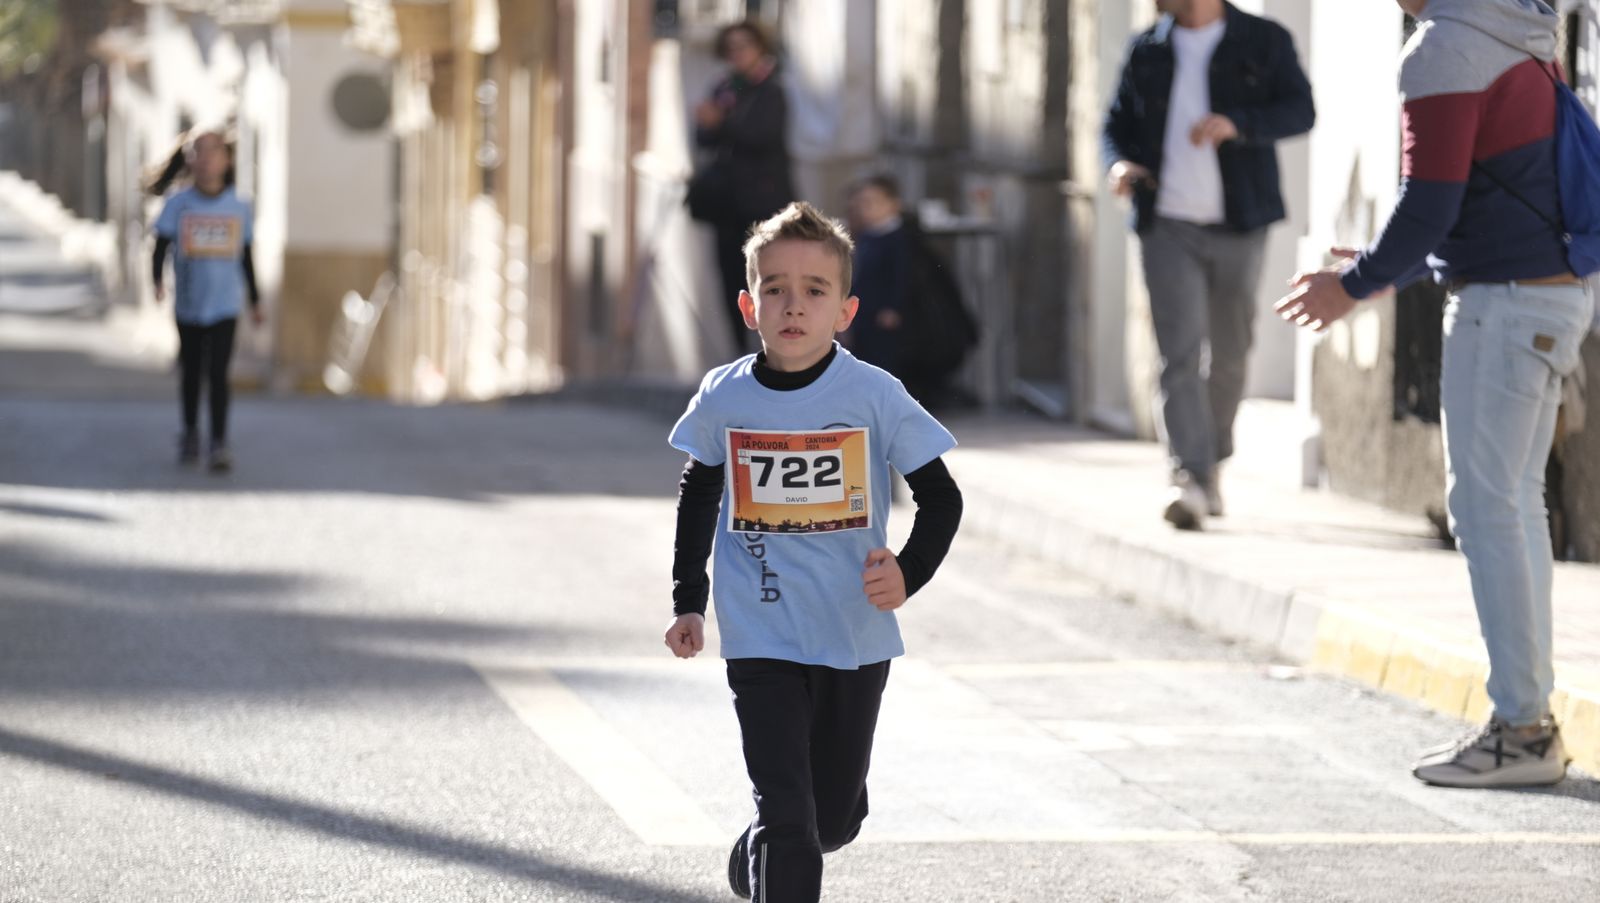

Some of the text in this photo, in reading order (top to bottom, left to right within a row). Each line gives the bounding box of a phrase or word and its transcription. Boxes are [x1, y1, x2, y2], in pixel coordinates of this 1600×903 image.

[741, 440, 751, 449] LA
[805, 436, 837, 444] CANTORIA
[751, 455, 841, 488] 722
